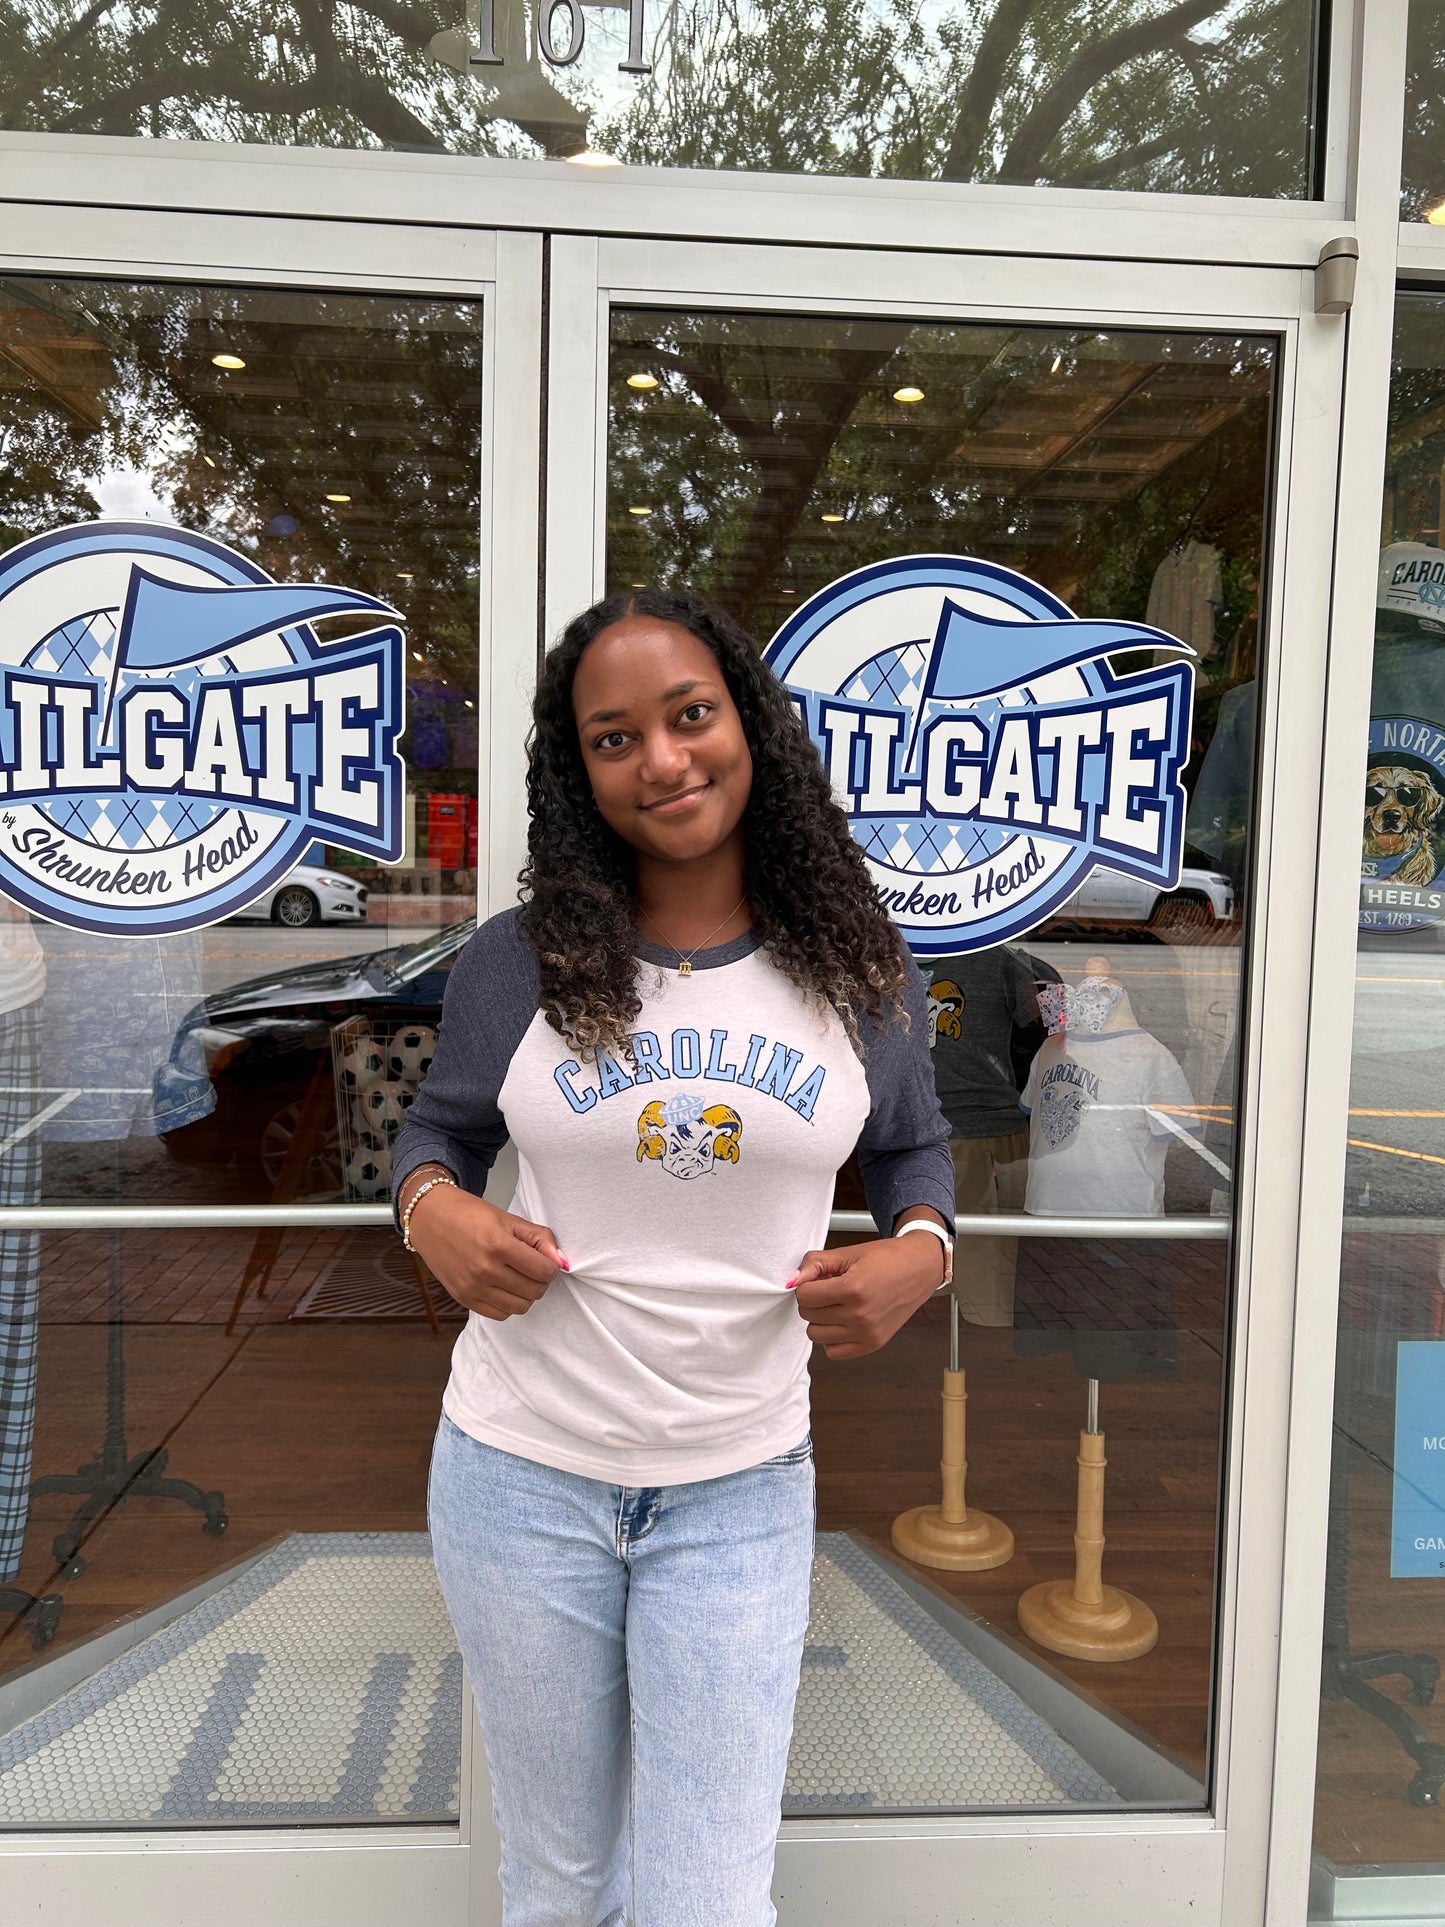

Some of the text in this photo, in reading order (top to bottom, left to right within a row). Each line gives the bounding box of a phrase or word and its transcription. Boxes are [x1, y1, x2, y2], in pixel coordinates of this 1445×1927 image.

[469, 0, 652, 74] 101
[1391, 560, 1445, 586] CARO
[0, 661, 380, 828] ILGATE
[791, 695, 1170, 855] ILGATE
[2, 810, 259, 894] by Shrunken Head
[971, 836, 1046, 909] Head
[1367, 889, 1442, 909] HEELS
[1386, 912, 1412, 926] 1789
[553, 1028, 827, 1122] CAROLINA
[1041, 1063, 1100, 1101] CAROLINA
[666, 1106, 703, 1124] UNC
